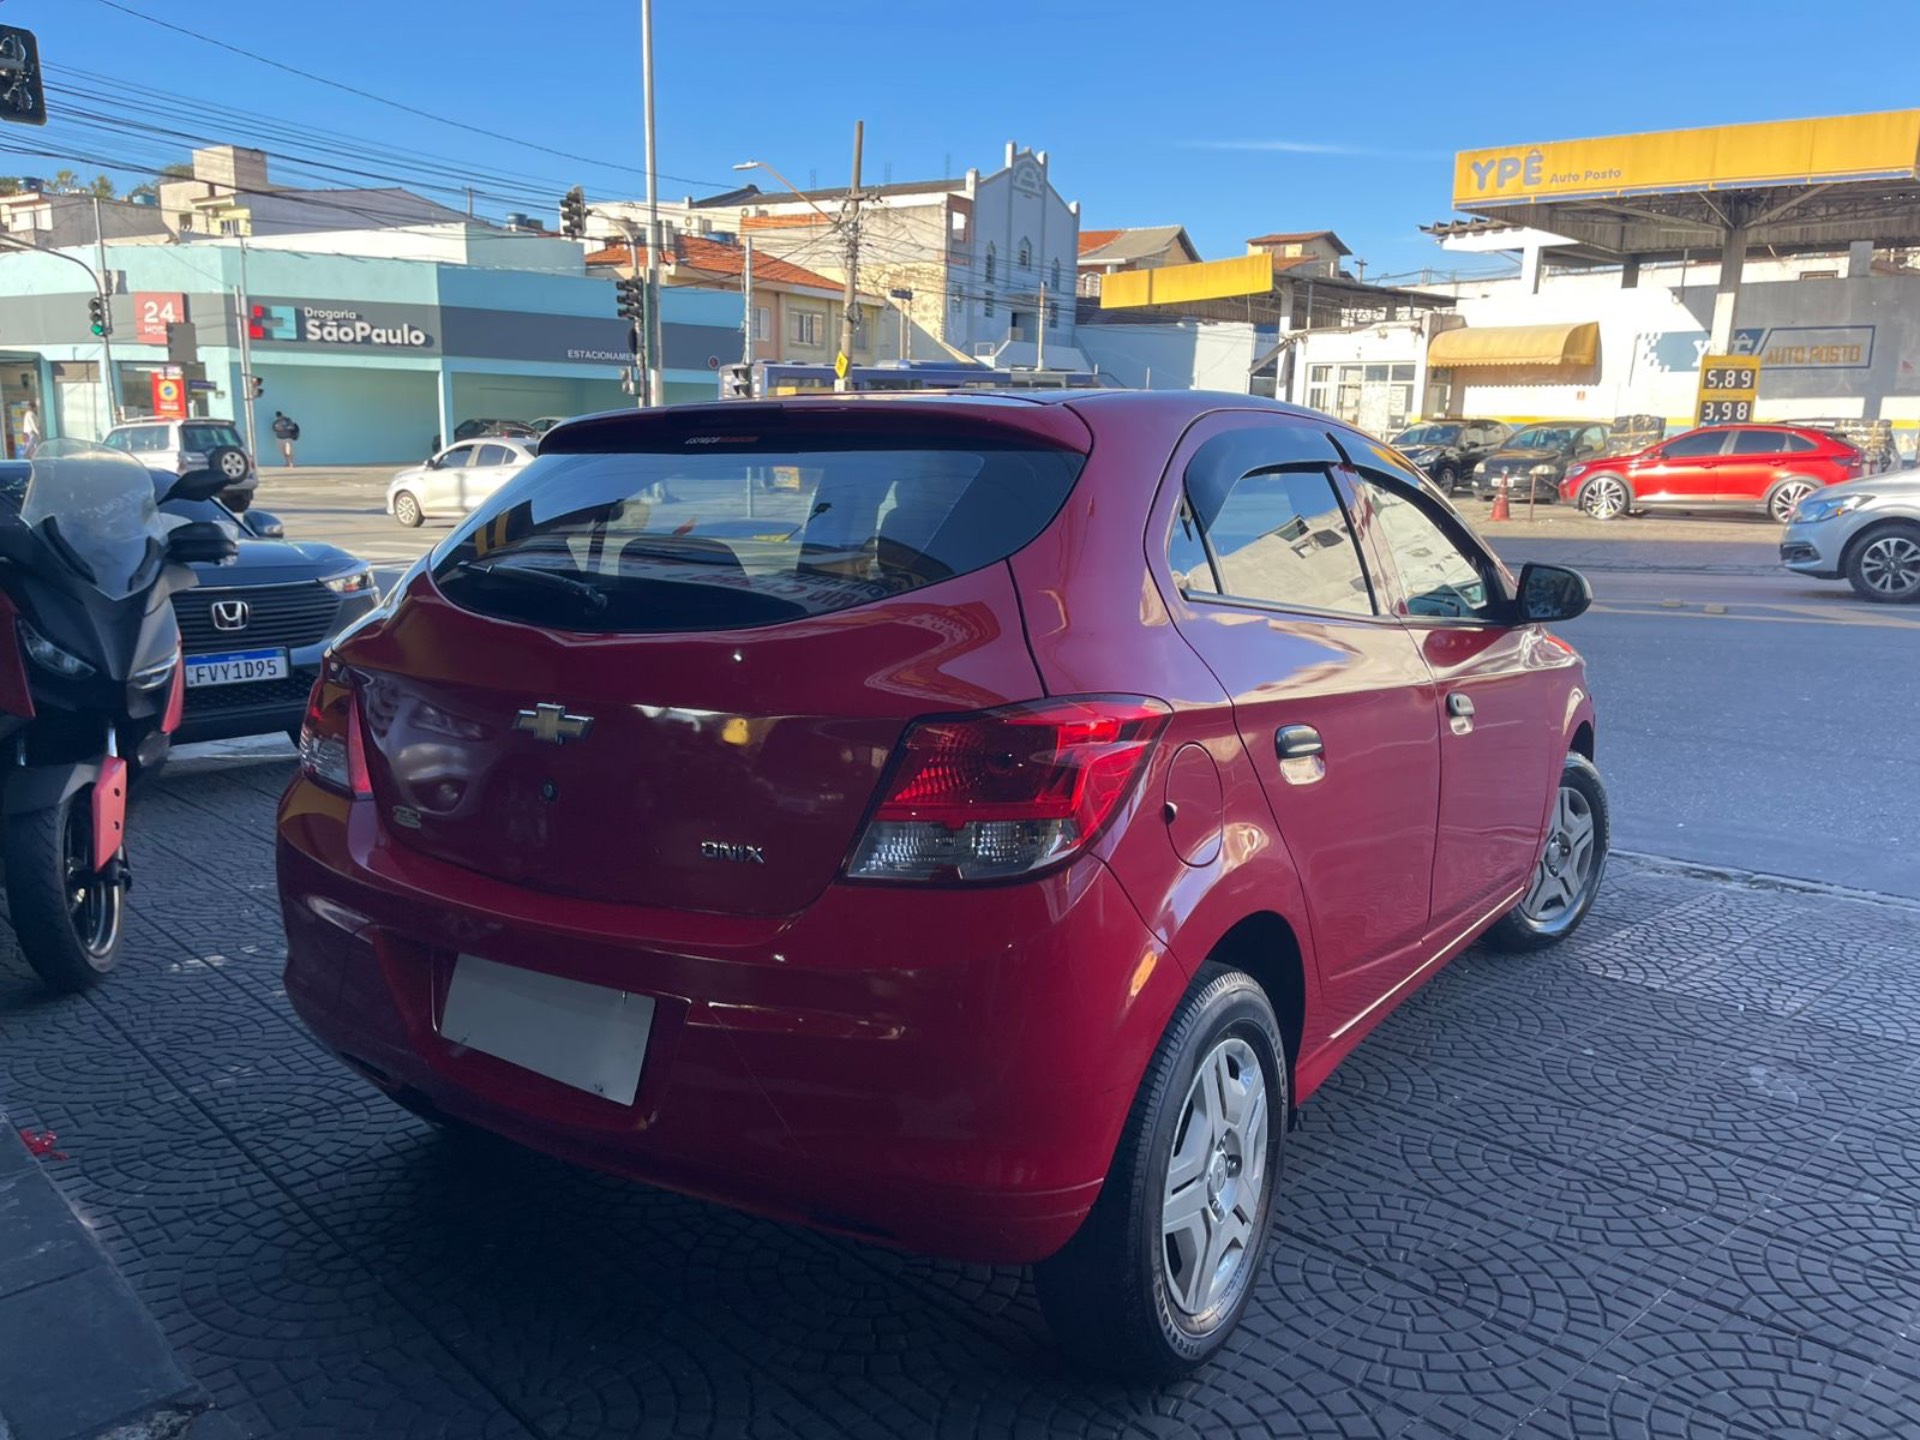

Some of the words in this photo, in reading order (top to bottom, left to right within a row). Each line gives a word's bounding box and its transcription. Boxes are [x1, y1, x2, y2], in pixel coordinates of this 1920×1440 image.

[1471, 149, 1544, 191] YPÊ
[1549, 173, 1580, 184] Auto
[1584, 169, 1621, 181] Posto
[144, 301, 175, 323] 24
[304, 307, 356, 320] Drogaria
[568, 349, 636, 361] ESTACIONAMEN
[1766, 346, 1804, 364] AUTO
[1809, 344, 1861, 364] POSTO
[1707, 369, 1752, 389] 5,89
[1704, 402, 1748, 421] 3,98
[195, 660, 277, 684] FVY1D95
[701, 842, 765, 863] ONIX
